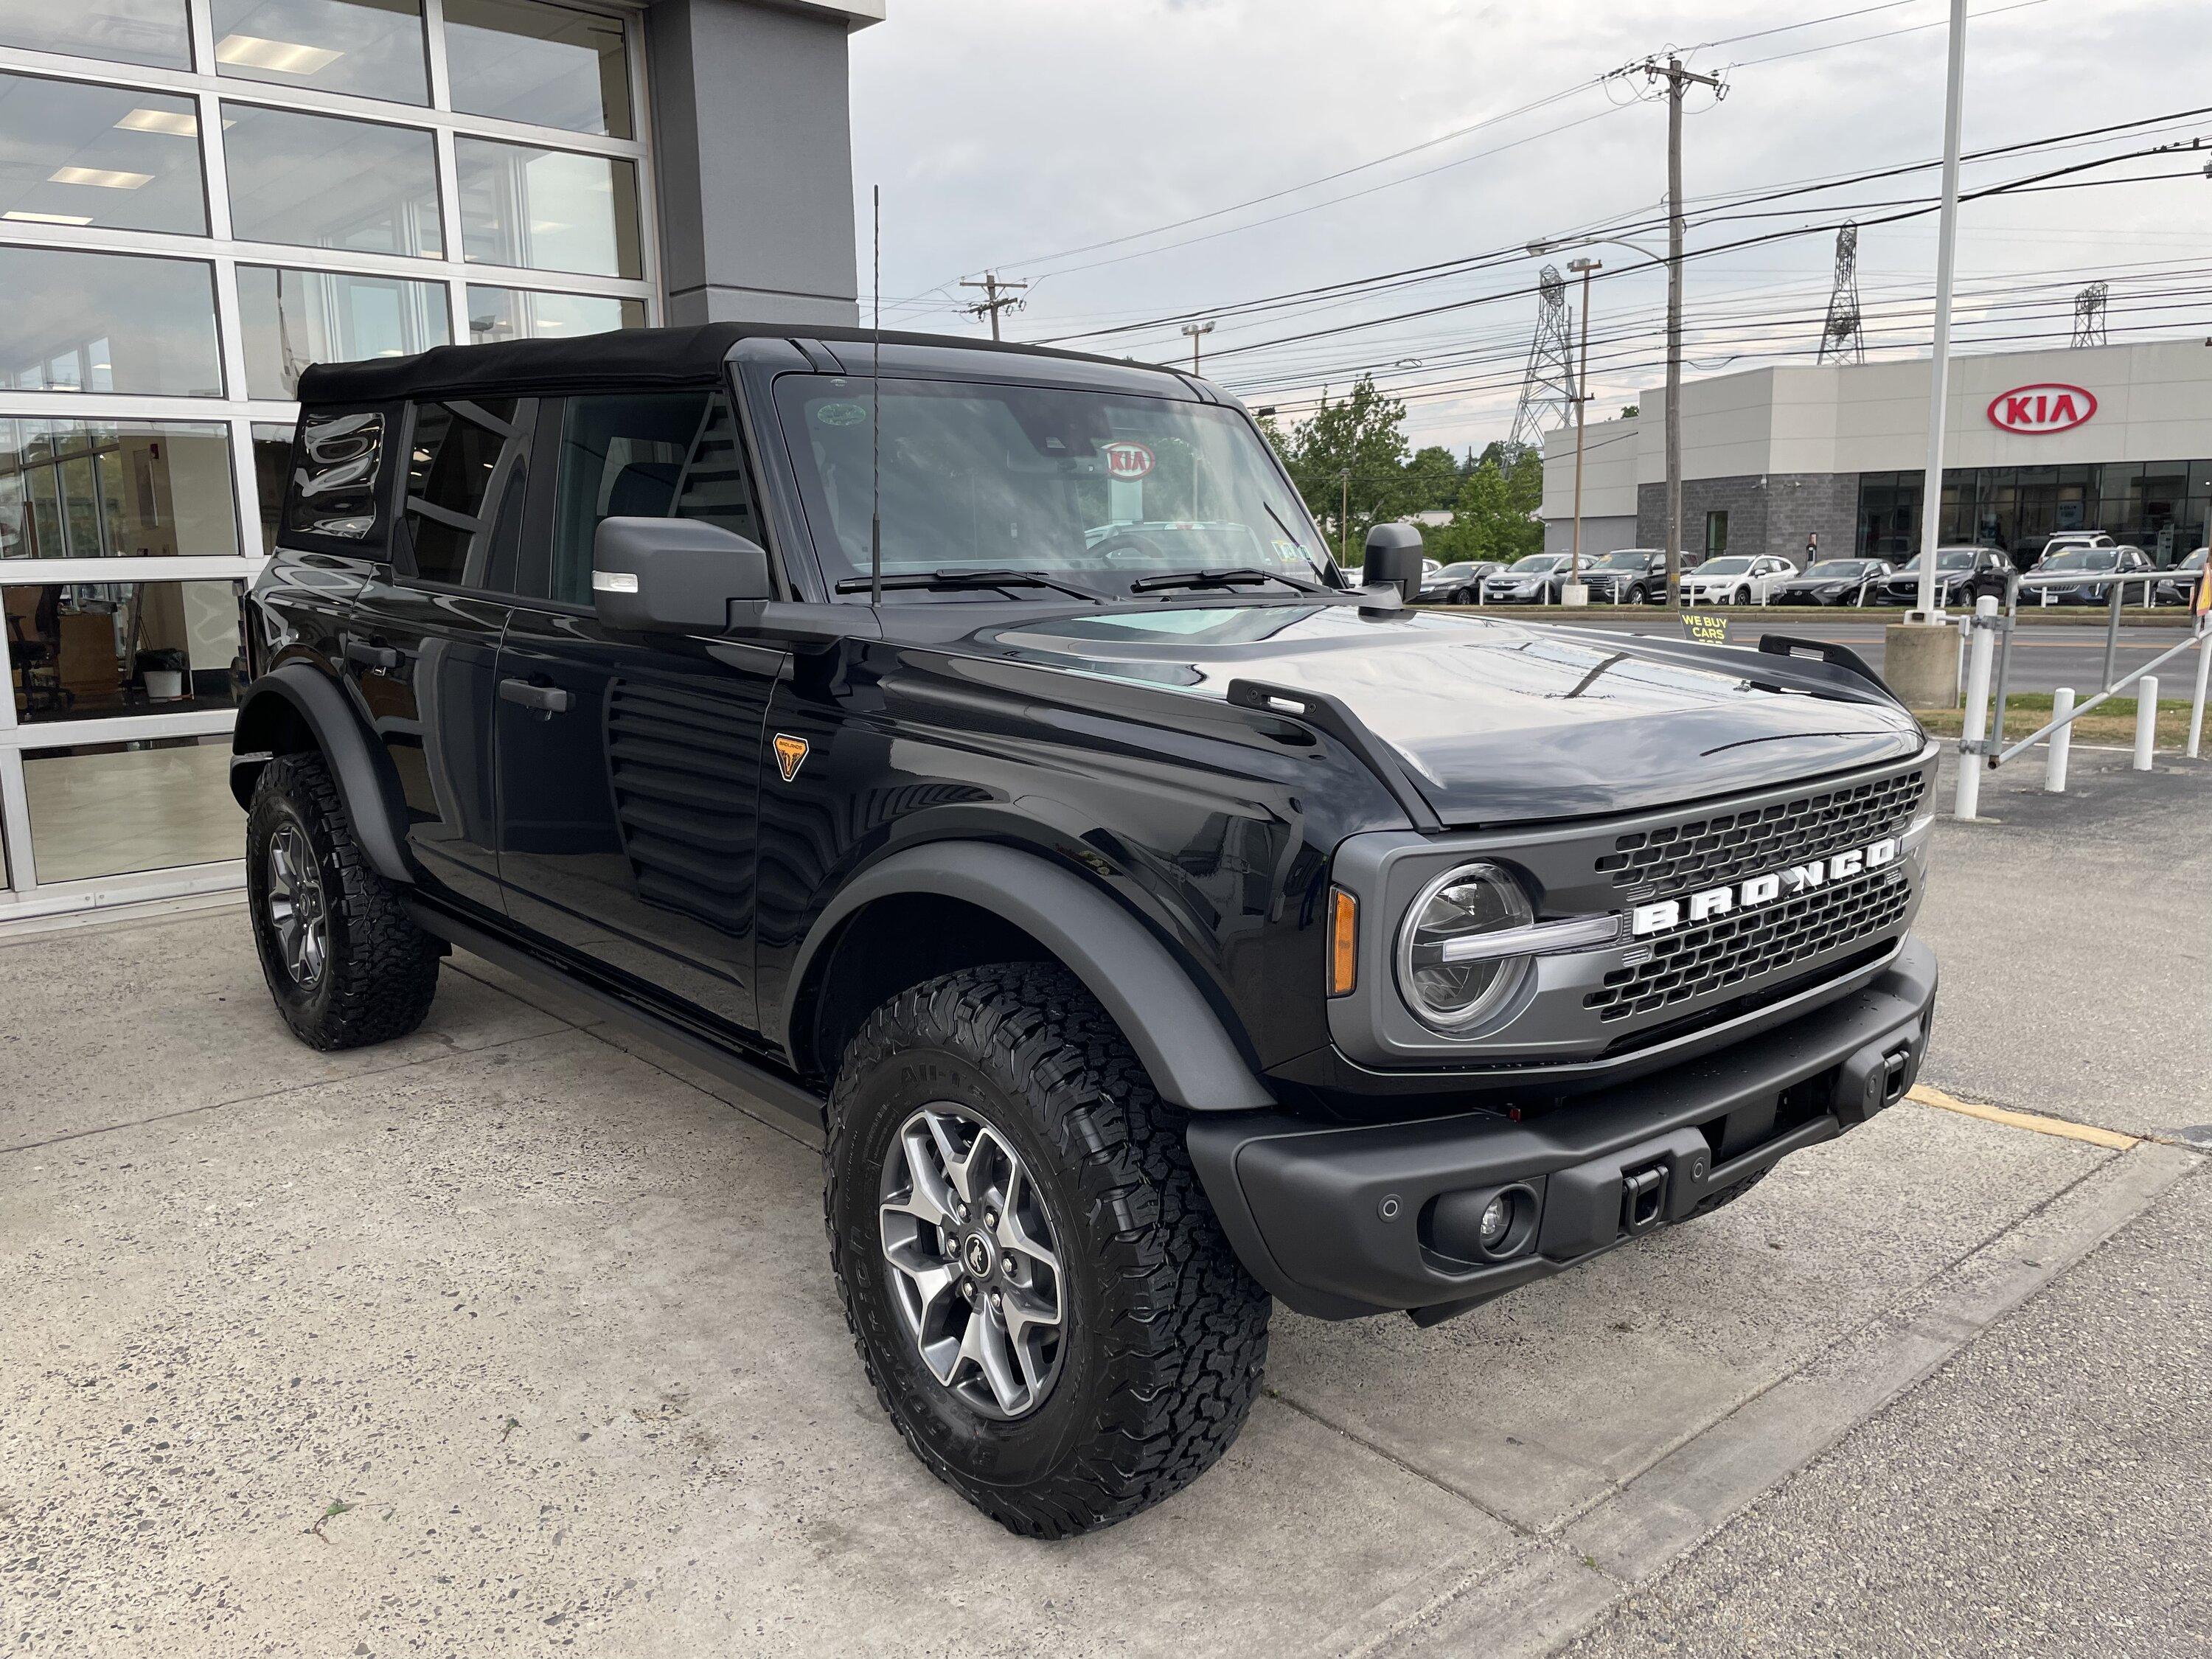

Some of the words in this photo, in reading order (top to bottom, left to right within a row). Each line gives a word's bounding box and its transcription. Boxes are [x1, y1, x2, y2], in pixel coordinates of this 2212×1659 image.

[2006, 394, 2078, 425] KIA
[1110, 451, 1147, 471] KIA
[1681, 614, 1703, 626] WE
[1703, 616, 1728, 629] BUY
[1692, 627, 1725, 640] CARS
[1632, 838, 1896, 935] BRONCO
